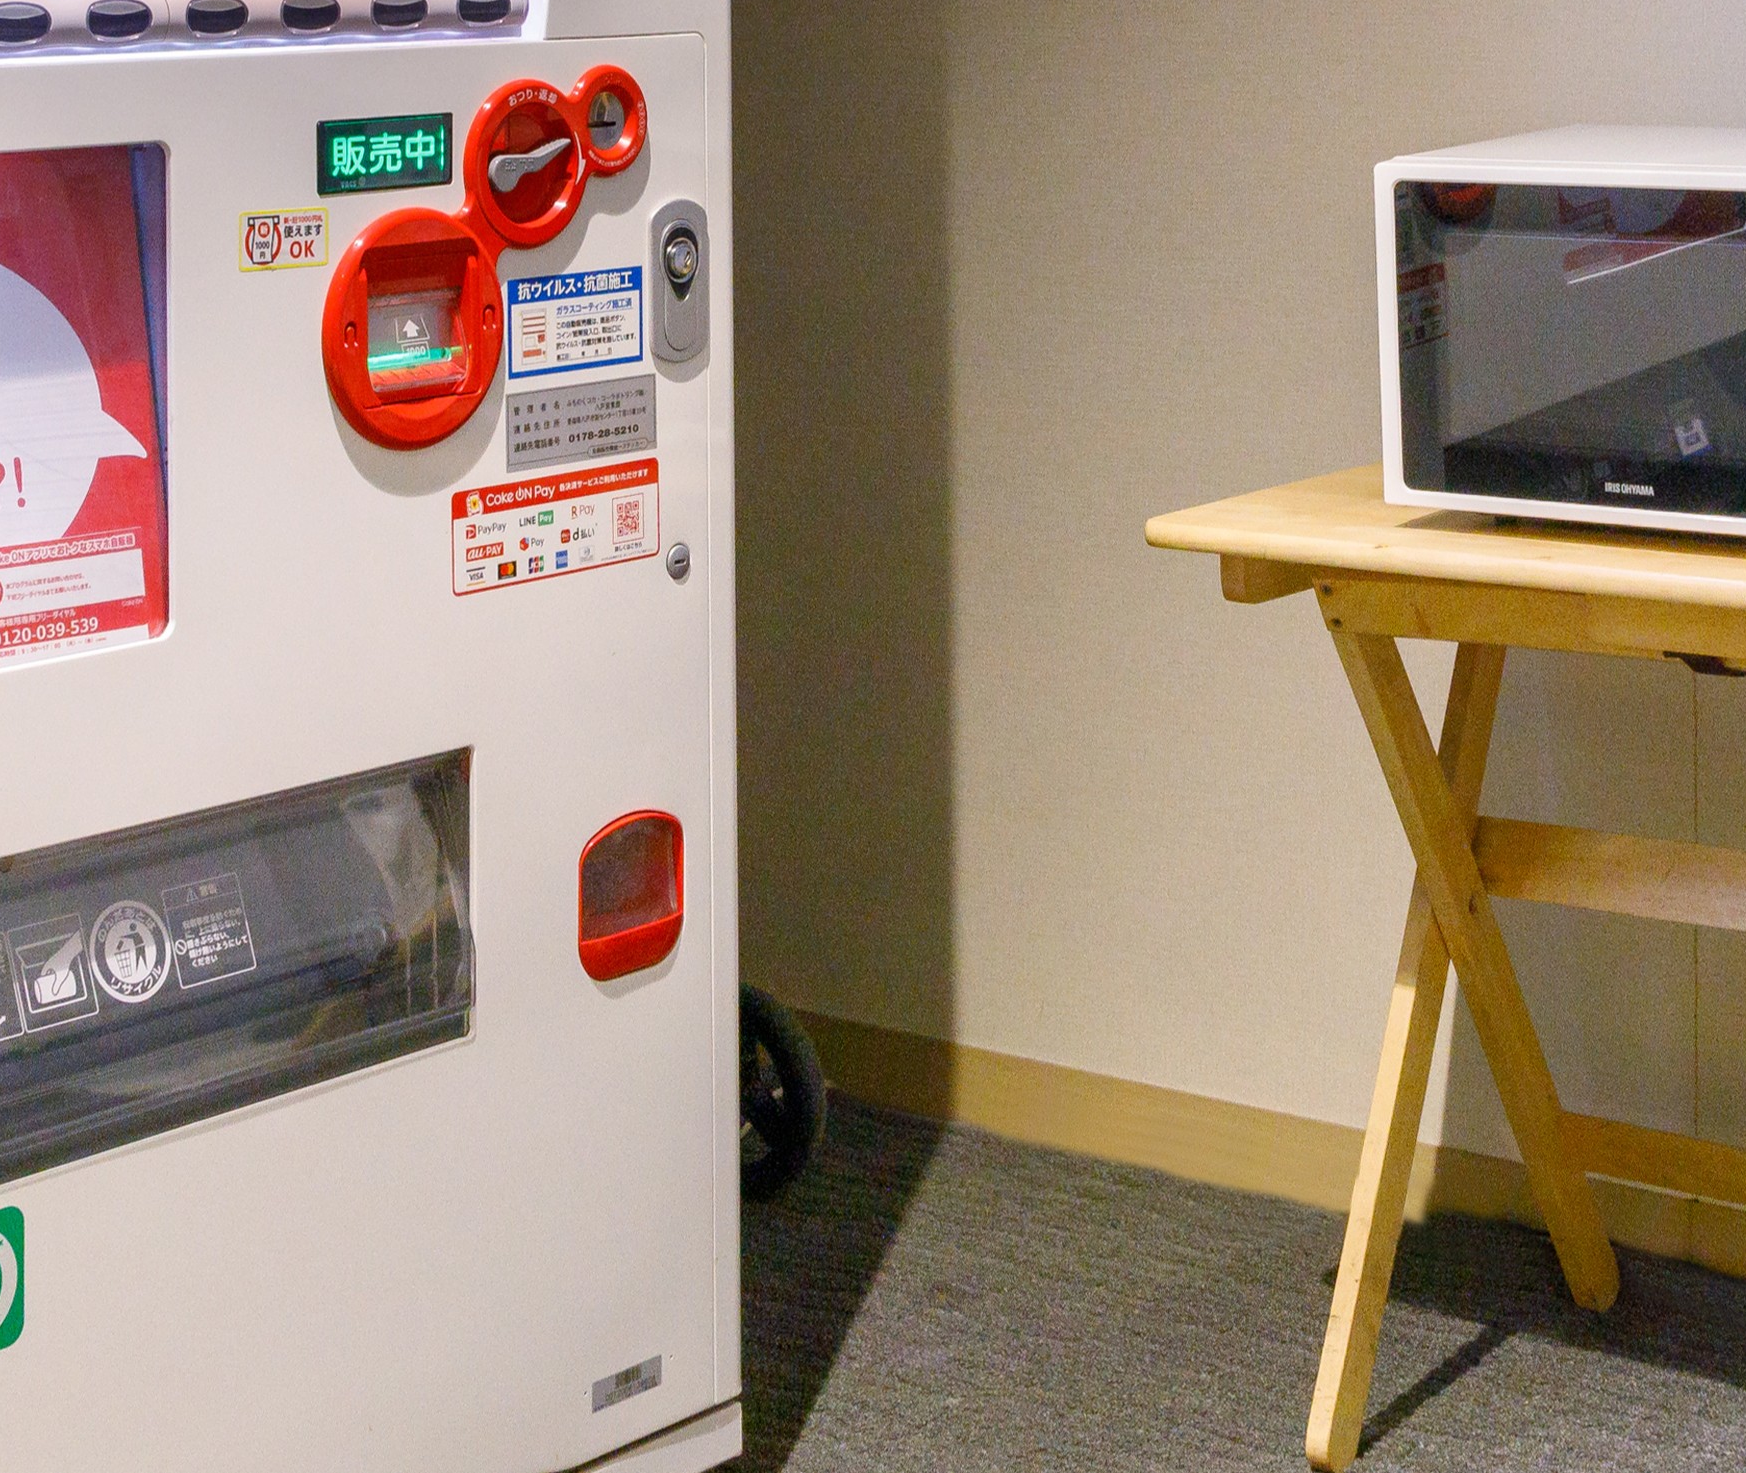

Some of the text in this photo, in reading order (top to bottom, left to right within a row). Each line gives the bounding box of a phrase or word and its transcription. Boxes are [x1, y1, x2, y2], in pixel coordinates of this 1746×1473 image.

[332, 129, 436, 176] 販売中
[284, 224, 323, 238] 使えます
[255, 241, 270, 250] 1000
[289, 240, 315, 258] OK
[518, 271, 633, 301] 抗ウイルス・抗菌施工
[486, 484, 556, 507] Coke ON Pay
[1605, 482, 1655, 496] IRIS OHYAMA
[519, 513, 554, 528] LINE Pay
[477, 522, 507, 534] PayPay
[531, 537, 545, 547] Pay
